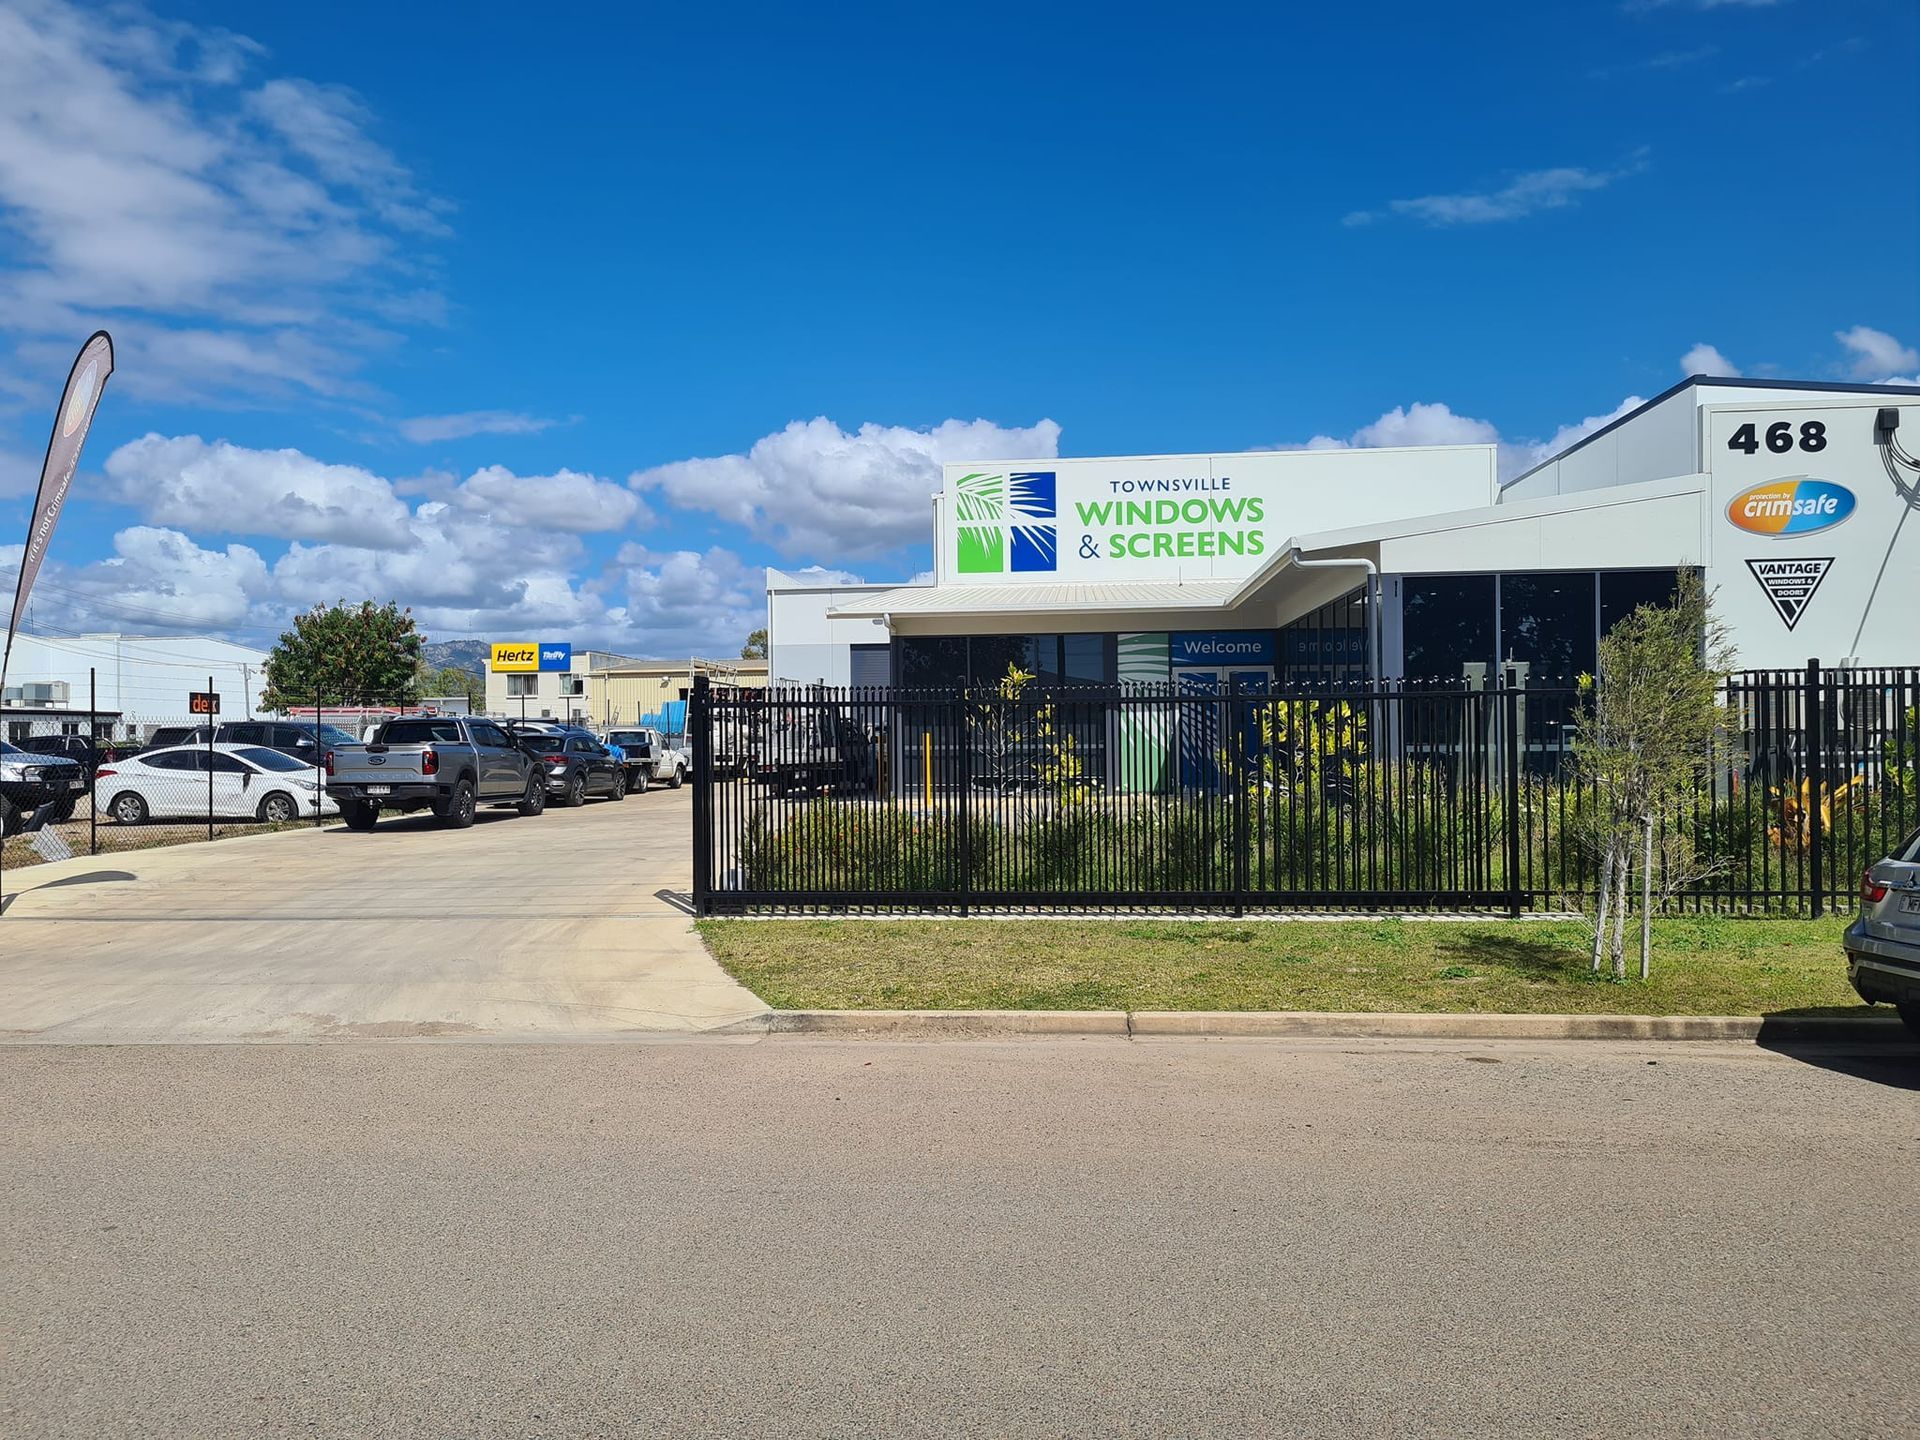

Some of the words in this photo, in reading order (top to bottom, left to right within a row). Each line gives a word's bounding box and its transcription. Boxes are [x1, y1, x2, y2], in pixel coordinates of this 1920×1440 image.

[1727, 420, 1827, 455] 468
[1109, 477, 1231, 493] TOWNSVILLE
[1745, 494, 1838, 517] crimsafe
[1782, 492, 1792, 501] by
[1075, 497, 1265, 527] WINDOWS
[39, 516, 51, 537] not
[1078, 534, 1101, 559] &
[1109, 530, 1265, 559] SCREENS
[1758, 563, 1822, 575] VANTAGE
[497, 649, 535, 662] Hertz
[1184, 640, 1262, 654] Welcome
